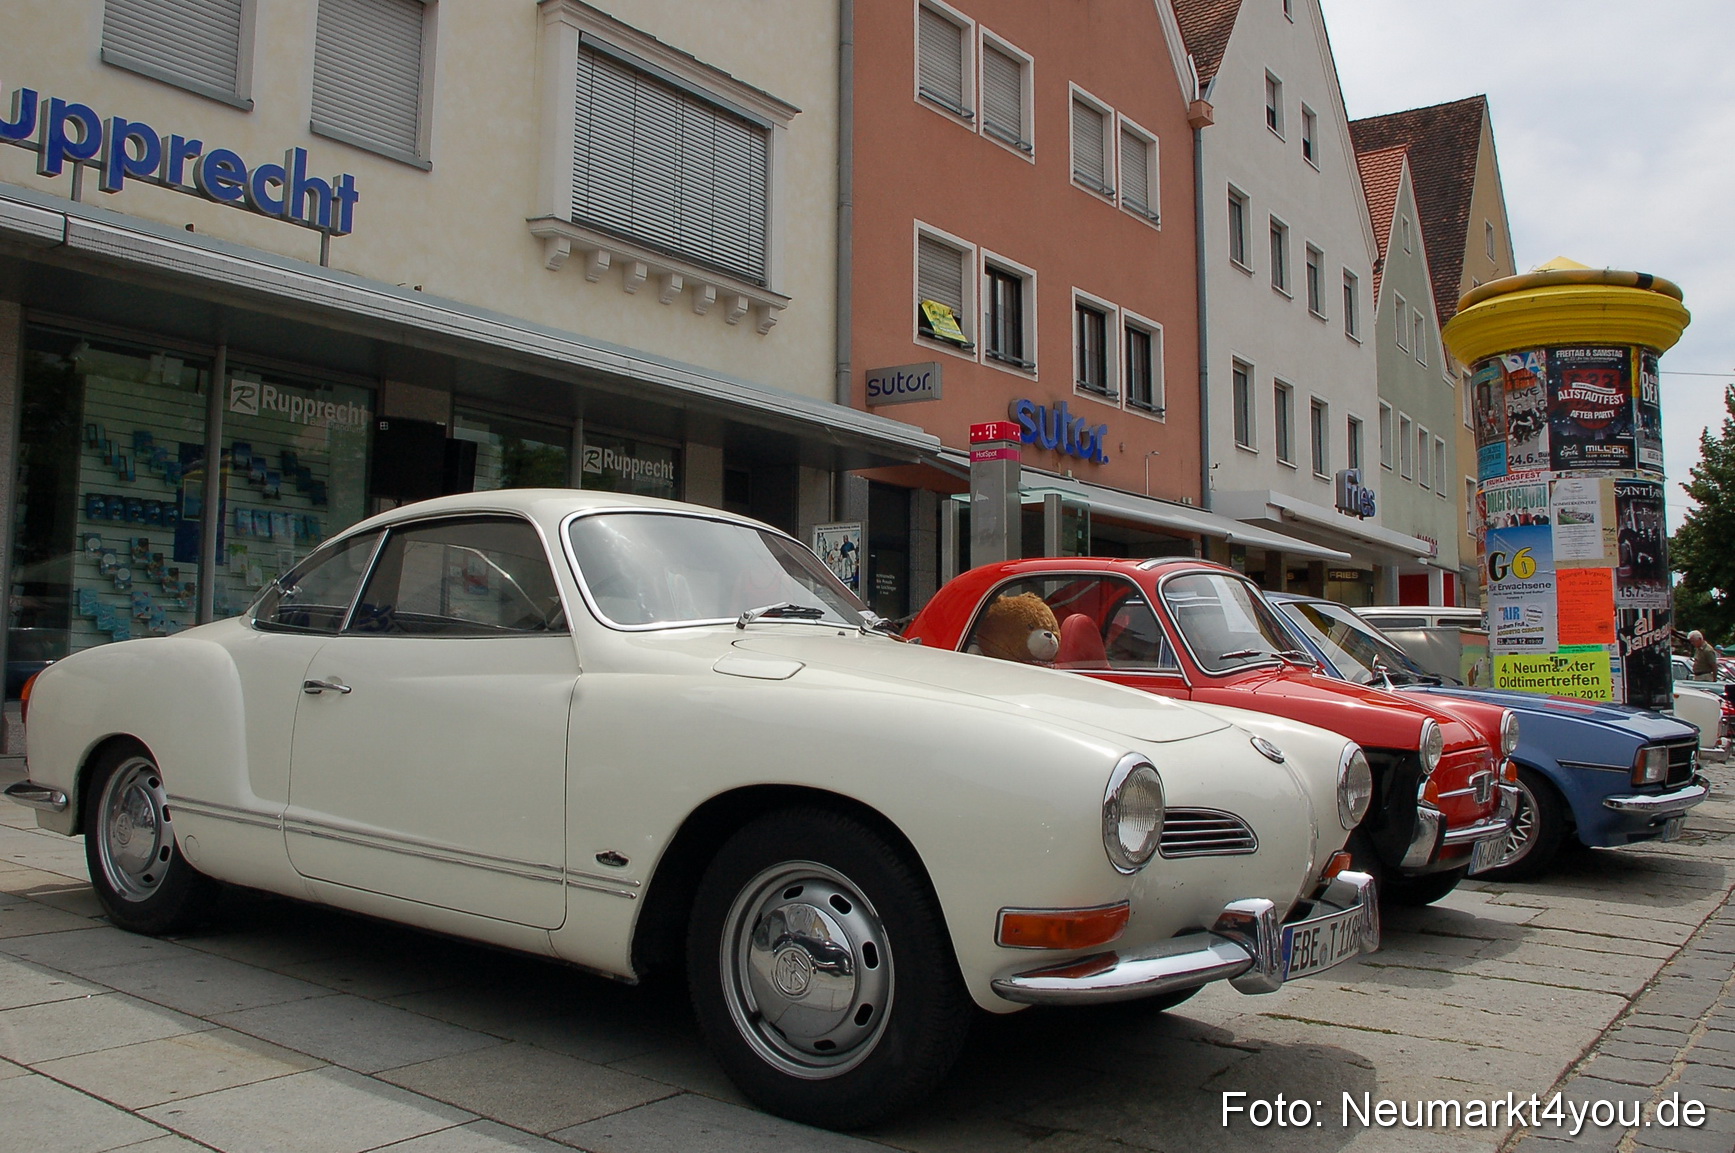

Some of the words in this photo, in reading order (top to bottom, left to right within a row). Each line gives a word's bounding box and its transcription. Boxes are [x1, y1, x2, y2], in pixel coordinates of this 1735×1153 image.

[1556, 349, 1585, 358] FREITAG
[1586, 349, 1592, 357] &
[1592, 349, 1623, 358] SAMSTAG
[1512, 386, 1540, 400] LIVE
[1557, 388, 1625, 405] ALTSTADTFEST
[262, 384, 369, 426] Rupprecht
[1570, 409, 1593, 419] AFTER
[1594, 409, 1615, 419] PARTY
[975, 450, 998, 459] HotSpot
[1508, 452, 1538, 466] 24.6.
[604, 448, 674, 480] Rupprecht
[1506, 486, 1547, 511] SIGNORI
[1329, 571, 1359, 580] FRIES
[1497, 581, 1552, 591] Erwachsene
[1618, 586, 1644, 598] 15.7.
[1503, 606, 1520, 620] AIR
[1501, 662, 1510, 674] 4.
[1499, 674, 1600, 688] Oldtimertreffen
[1580, 689, 1606, 699] 2012
[1288, 927, 1321, 973] EBE
